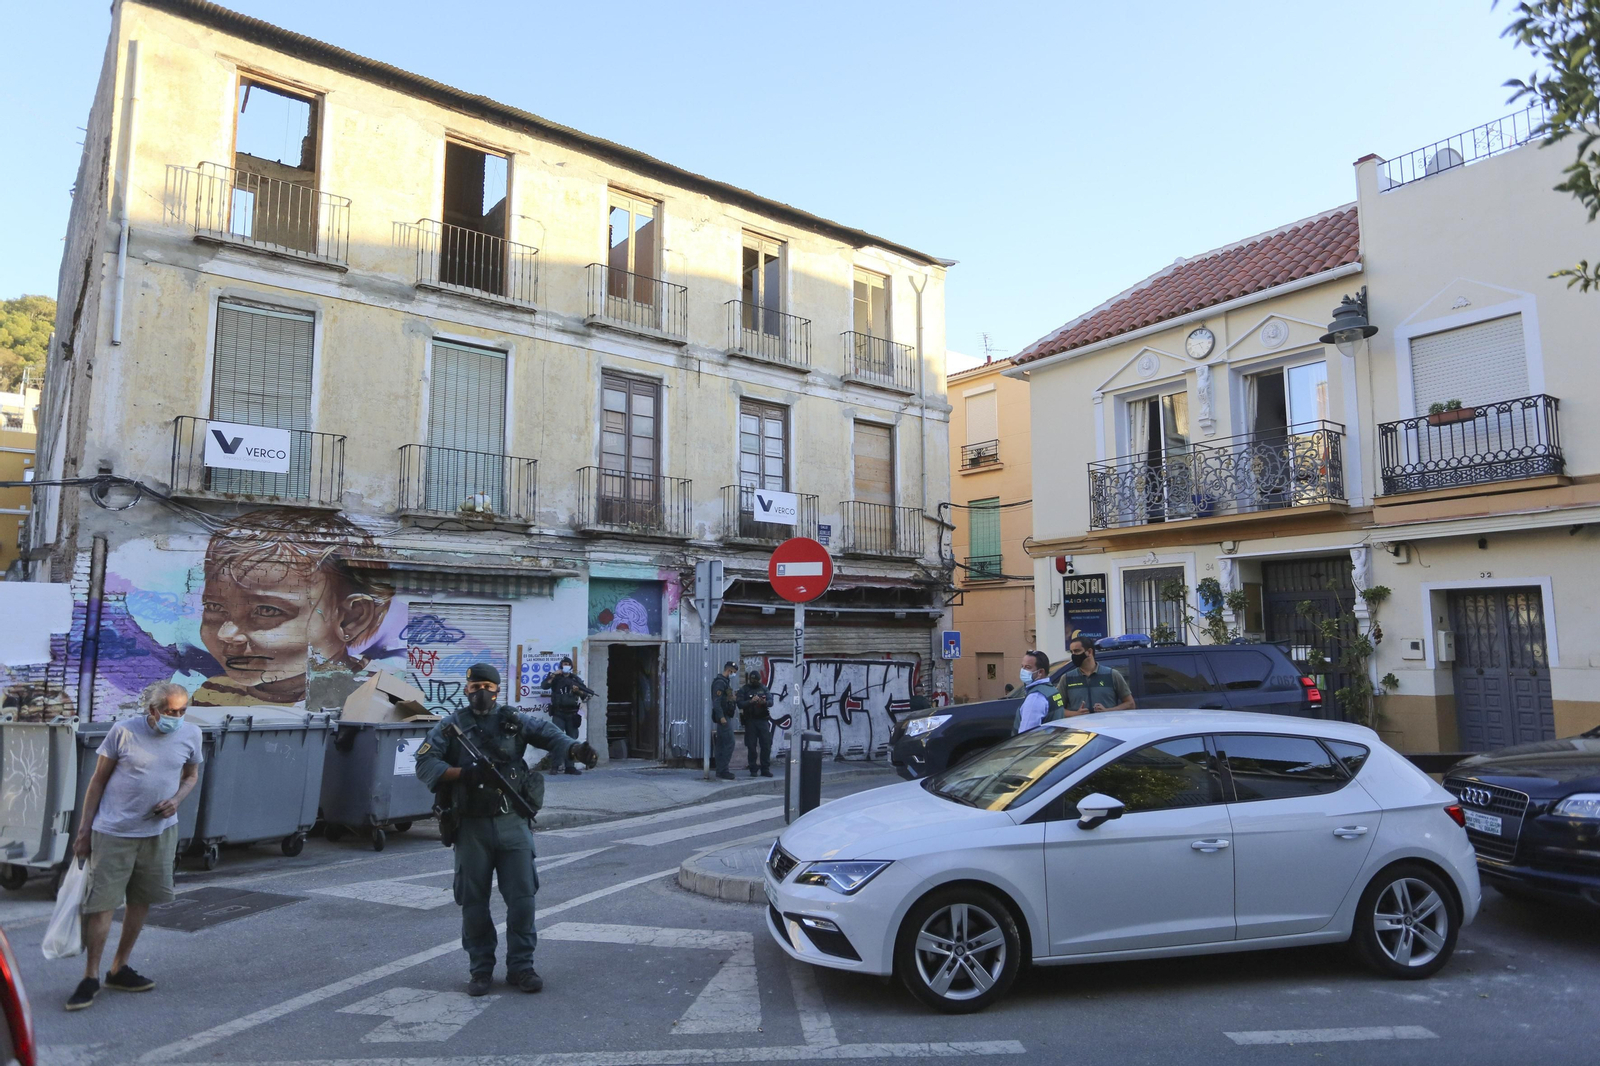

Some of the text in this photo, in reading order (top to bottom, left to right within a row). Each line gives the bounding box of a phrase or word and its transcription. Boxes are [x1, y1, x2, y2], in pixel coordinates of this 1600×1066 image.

[246, 446, 287, 460] VERCO
[774, 506, 795, 516] VERCO
[1205, 563, 1215, 571] 34
[1480, 571, 1492, 579] 32
[1065, 578, 1105, 595] HOSTAL
